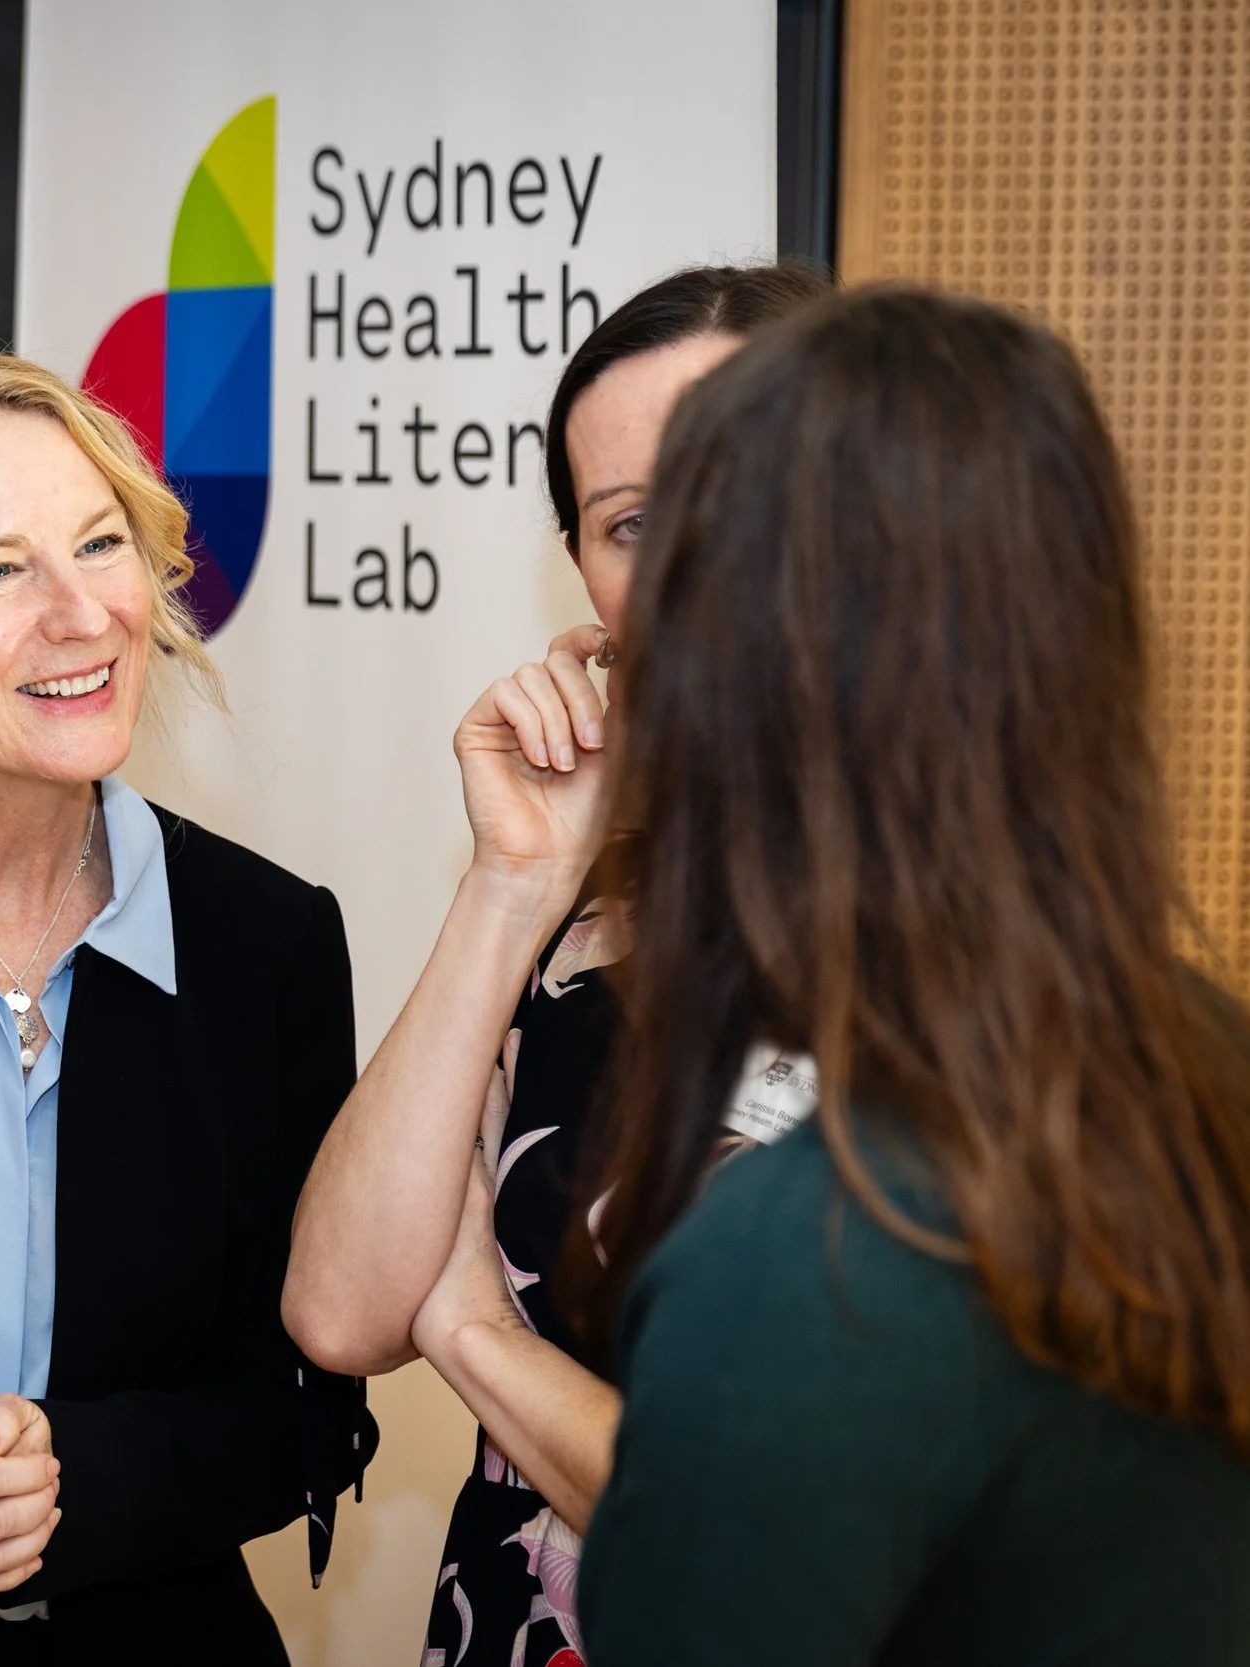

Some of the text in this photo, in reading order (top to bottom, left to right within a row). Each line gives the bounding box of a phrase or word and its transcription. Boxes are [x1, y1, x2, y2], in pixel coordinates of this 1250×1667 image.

[310, 138, 603, 257] Sydney
[308, 263, 600, 361] Health
[307, 396, 547, 488] Liter
[305, 521, 440, 614] Lab
[788, 1076, 819, 1097] SYDN
